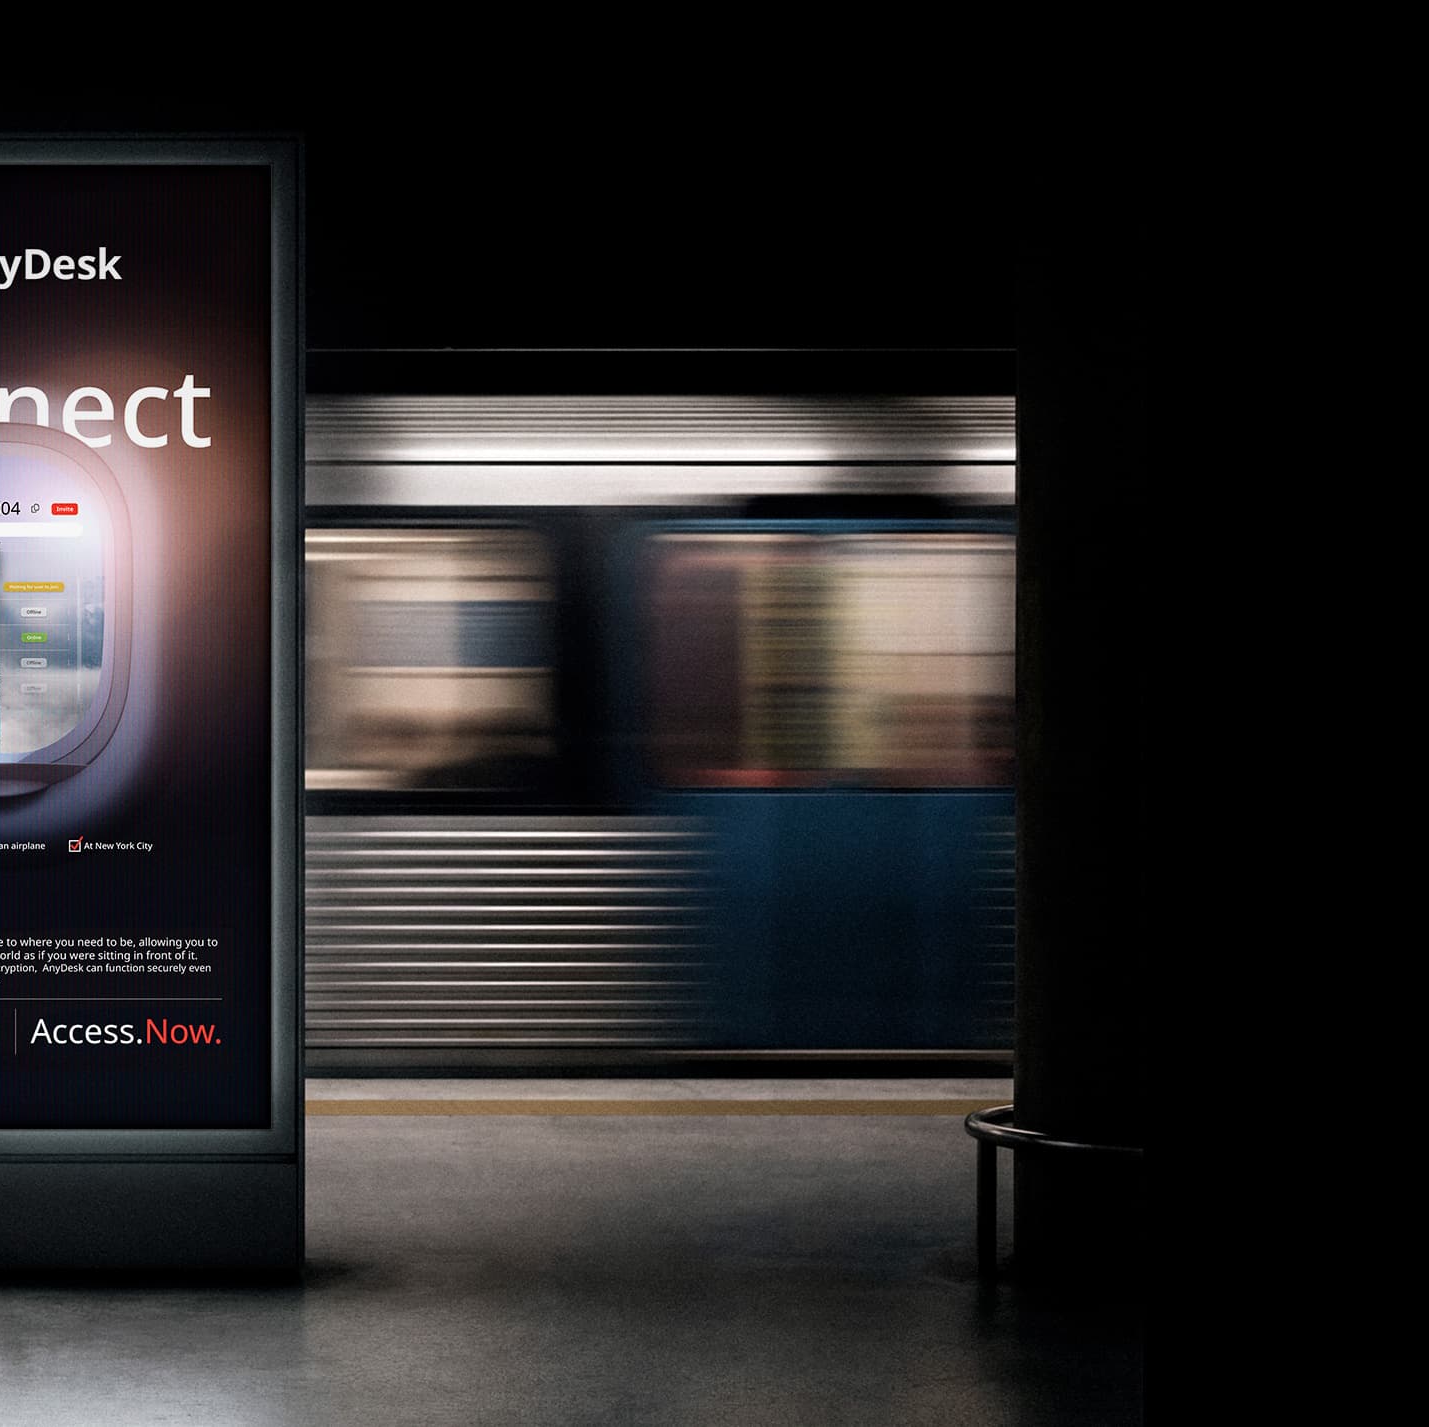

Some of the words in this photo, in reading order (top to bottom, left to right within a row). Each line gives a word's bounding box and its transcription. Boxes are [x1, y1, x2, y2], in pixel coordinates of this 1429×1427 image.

[56, 505, 75, 513] Invite
[10, 841, 46, 852] airplane
[83, 842, 94, 850] At
[95, 842, 115, 850] New
[116, 841, 135, 850] York
[136, 841, 153, 852] City
[6, 937, 18, 947] to
[19, 937, 53, 947] where
[54, 939, 75, 950] you
[77, 937, 104, 947] need
[106, 937, 118, 947] to
[119, 937, 136, 950] be,
[138, 937, 183, 950] allowing
[184, 939, 205, 950] you
[206, 937, 219, 947] to
[23, 952, 36, 961] as
[37, 950, 47, 961] if
[46, 952, 68, 963] you
[68, 952, 97, 961] were
[97, 950, 132, 963] sitting
[133, 950, 144, 961] in
[145, 950, 173, 961] front
[174, 950, 188, 961] of
[188, 950, 198, 961] it.
[42, 963, 84, 975] AnyDesk
[85, 965, 103, 973] can
[105, 963, 145, 973] function
[146, 963, 187, 975] securely
[188, 965, 212, 973] even
